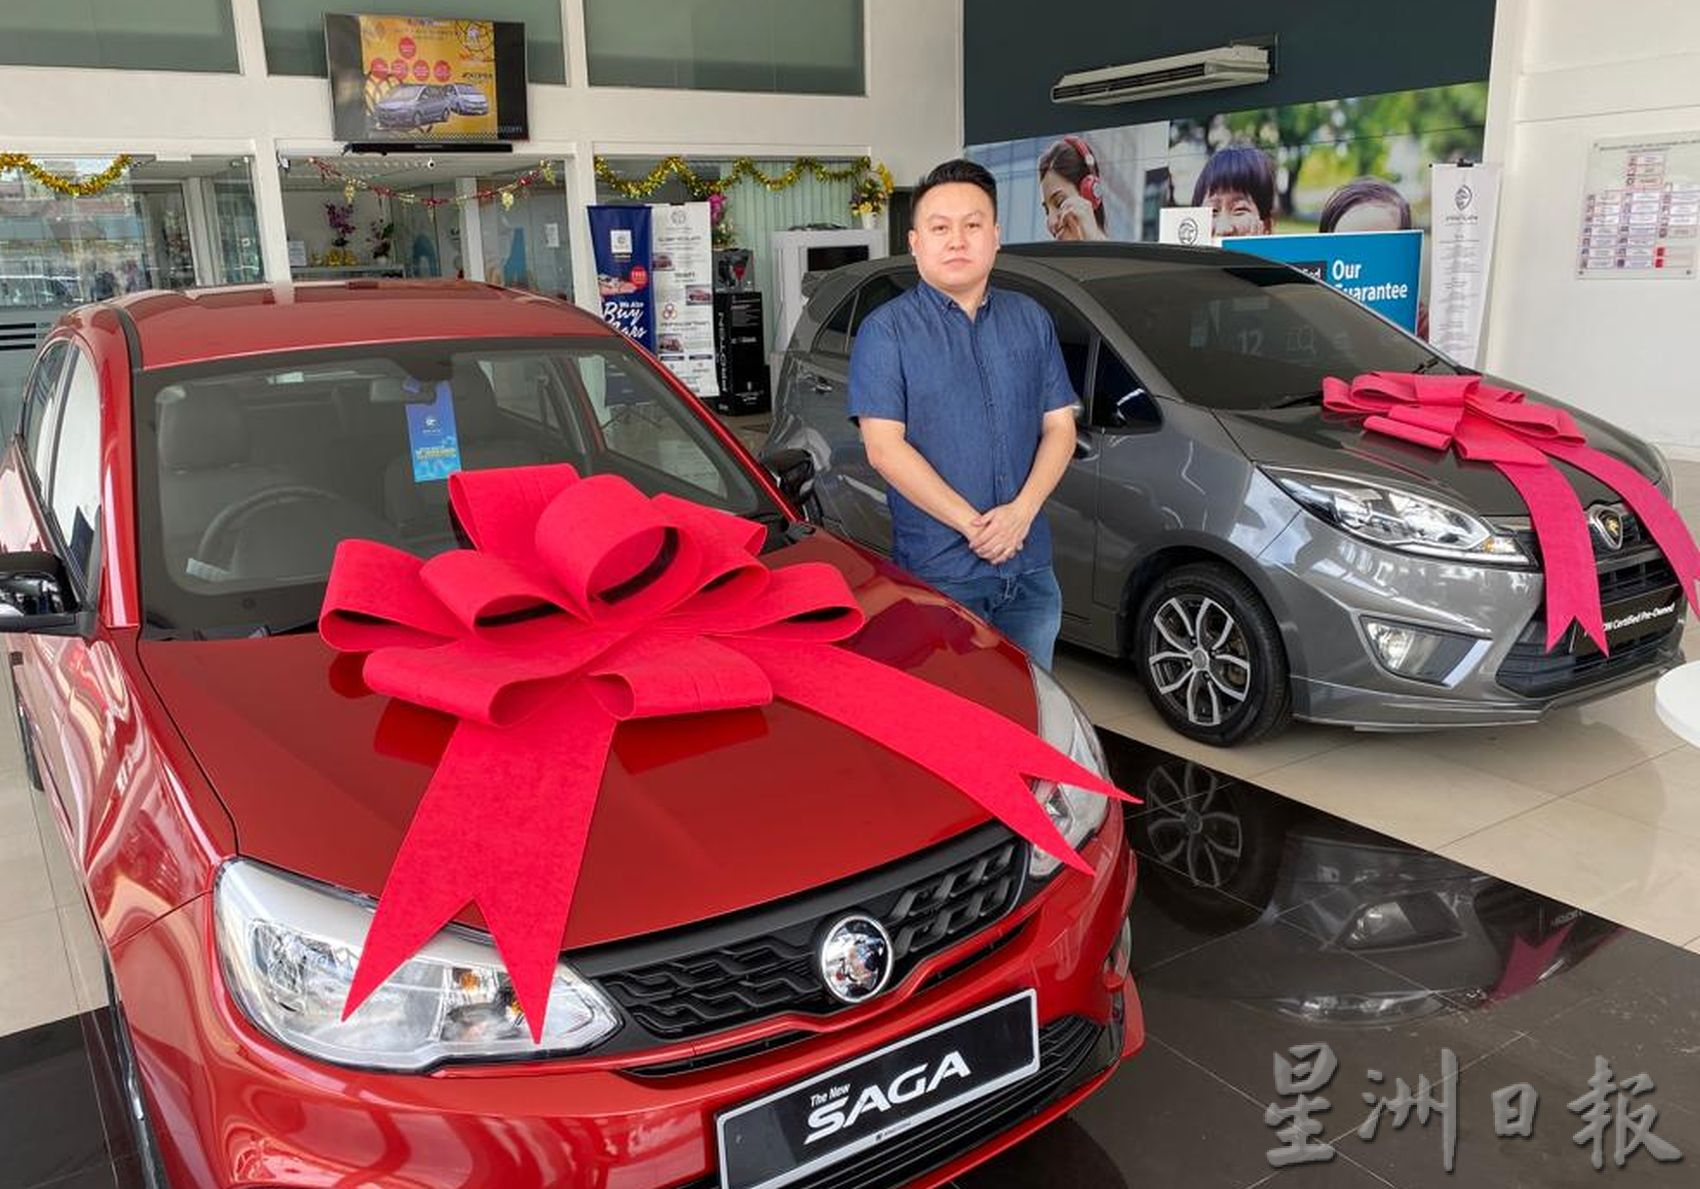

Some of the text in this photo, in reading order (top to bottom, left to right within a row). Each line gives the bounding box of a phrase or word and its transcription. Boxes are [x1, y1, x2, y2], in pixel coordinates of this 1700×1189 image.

[1332, 260, 1362, 280] Our
[604, 302, 644, 326] Buy
[804, 1050, 971, 1145] SAGA
[810, 1083, 851, 1107] The New
